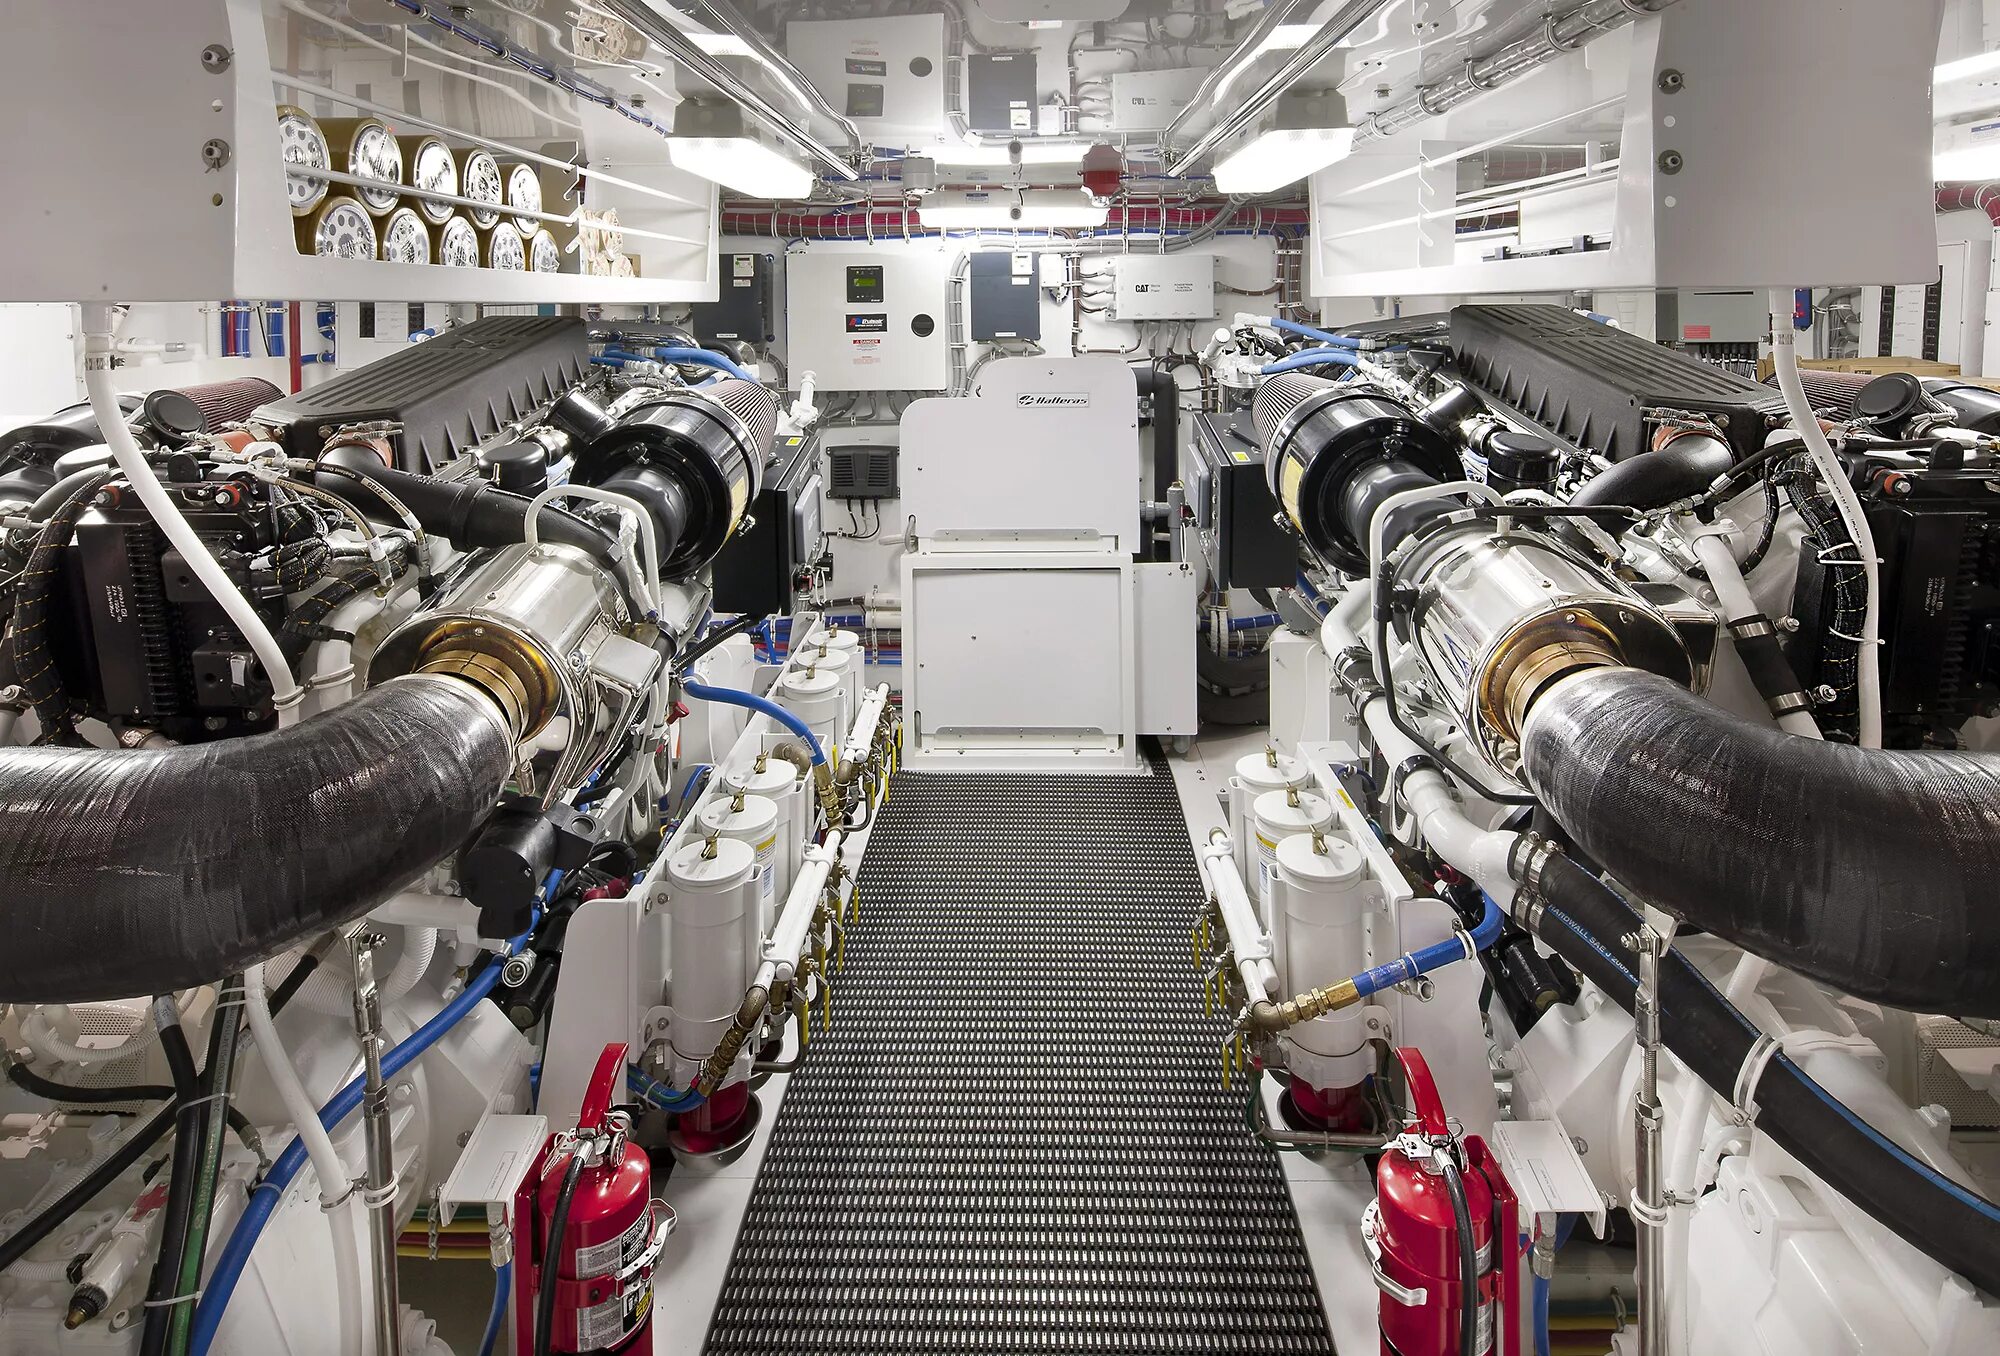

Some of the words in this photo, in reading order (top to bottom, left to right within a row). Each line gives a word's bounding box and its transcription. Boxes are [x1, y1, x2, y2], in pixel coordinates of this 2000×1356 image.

[1135, 284, 1150, 292] CAT
[1548, 904, 1588, 939] HARDWALL
[1589, 936, 1606, 952] SAE
